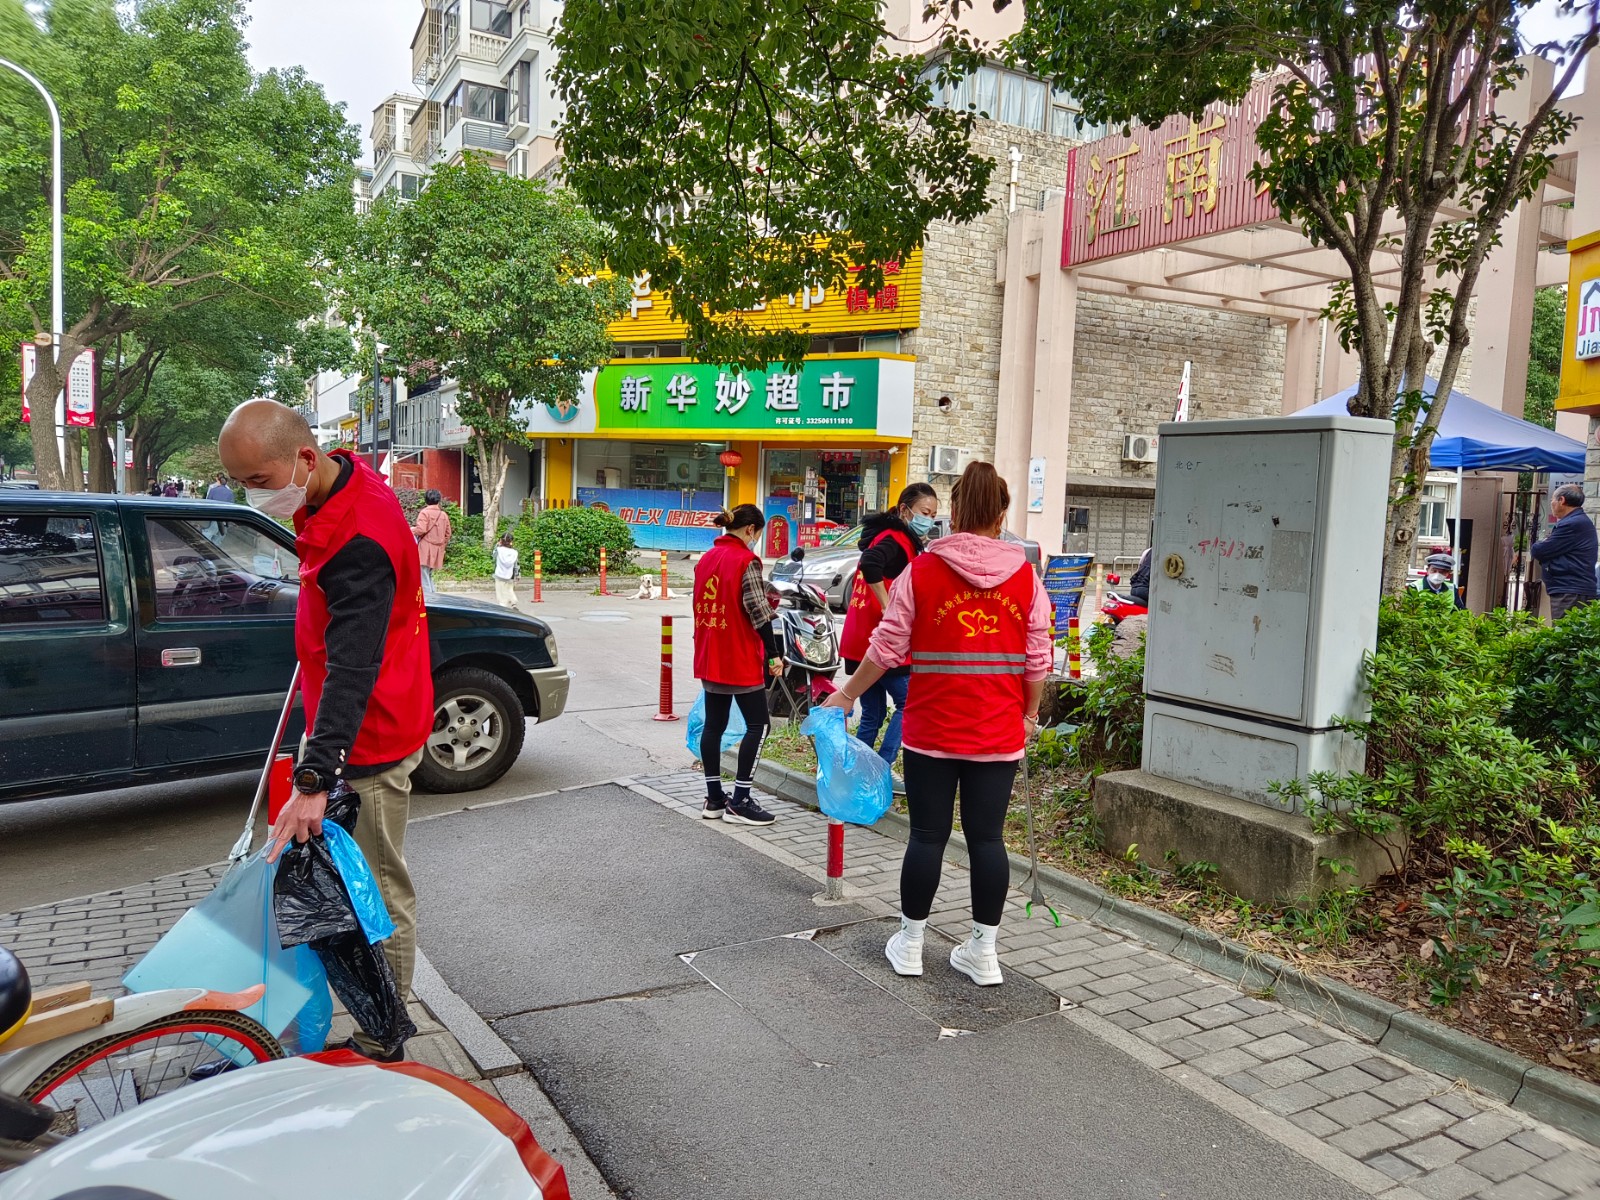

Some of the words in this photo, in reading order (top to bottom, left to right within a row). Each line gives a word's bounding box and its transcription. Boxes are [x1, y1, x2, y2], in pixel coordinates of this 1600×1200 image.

[846, 284, 899, 313] 棋牌
[619, 371, 856, 415] 新华妙超市
[619, 506, 663, 525] 怕上火
